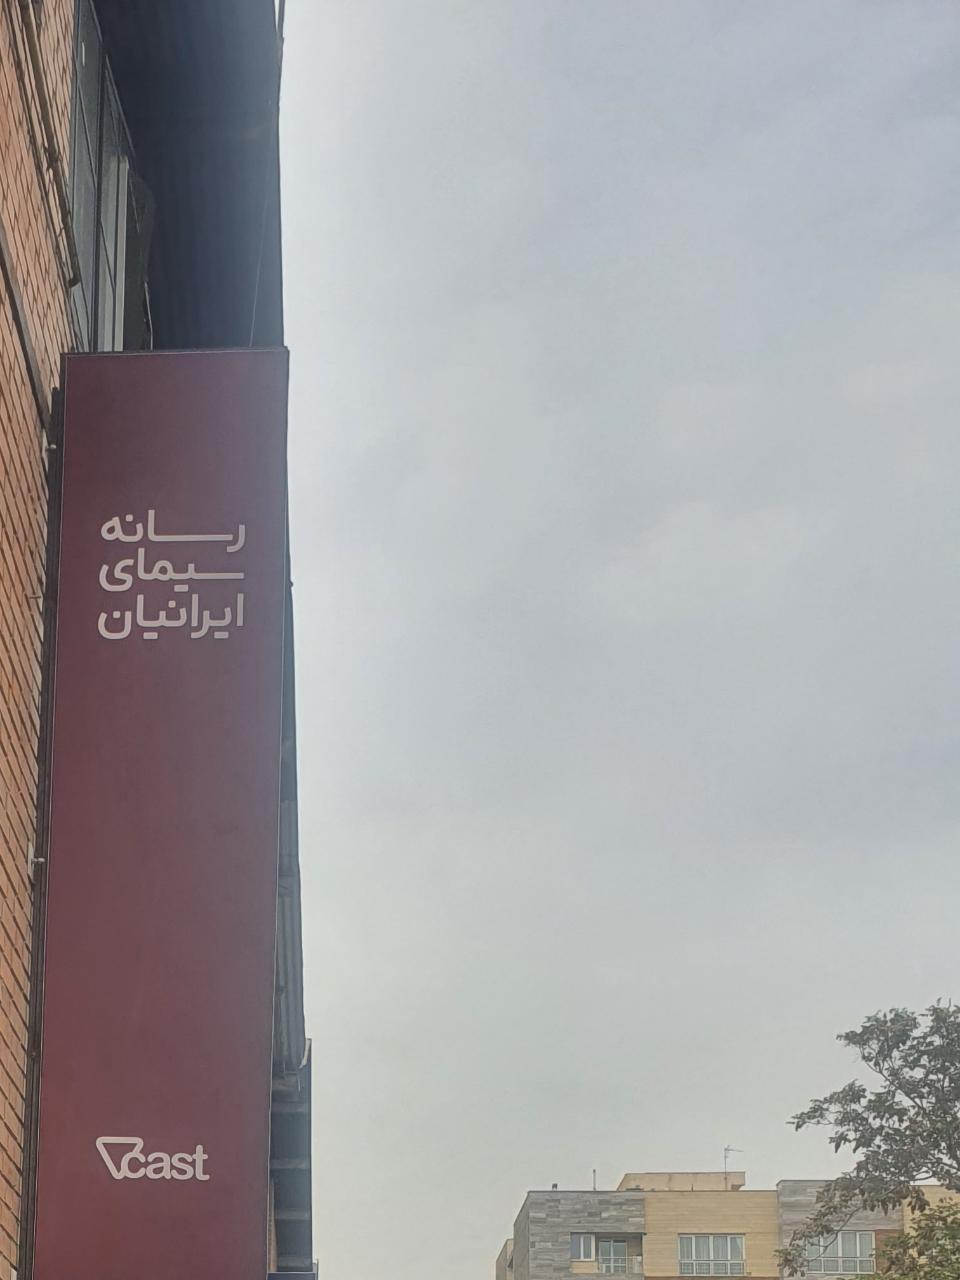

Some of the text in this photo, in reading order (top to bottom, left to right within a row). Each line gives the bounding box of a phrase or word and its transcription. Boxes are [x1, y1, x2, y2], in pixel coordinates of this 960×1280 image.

[100, 509, 246, 553] رسانه
[98, 547, 245, 592] سیمای
[97, 593, 244, 640] ایرانیان
